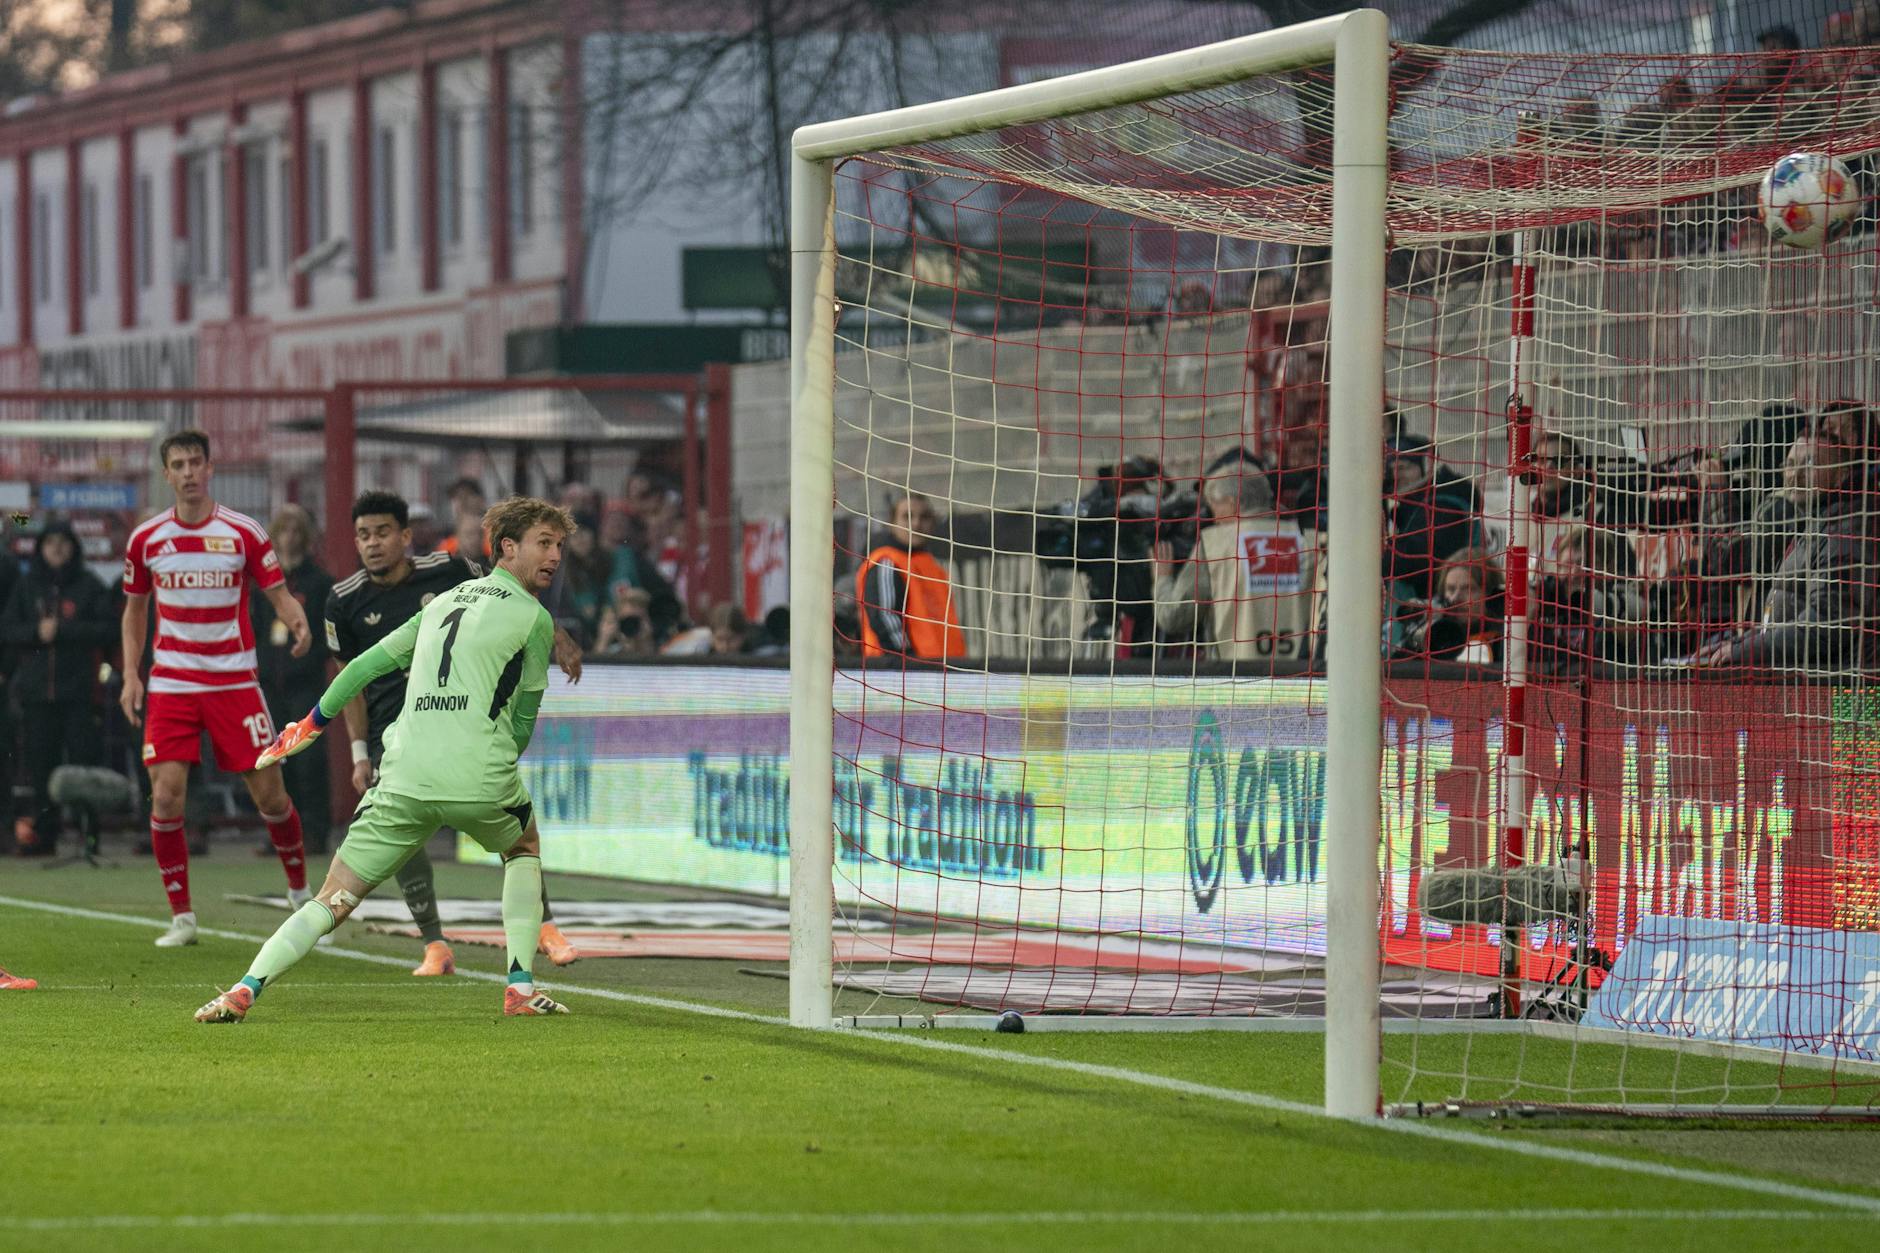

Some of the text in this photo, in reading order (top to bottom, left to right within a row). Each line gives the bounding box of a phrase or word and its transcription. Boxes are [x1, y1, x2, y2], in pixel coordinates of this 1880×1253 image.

[173, 569, 233, 588] raisin
[469, 585, 512, 600] UNION
[453, 594, 480, 604] BERLIN
[438, 607, 468, 688] 1
[1255, 629, 1295, 656] 05
[415, 691, 469, 712] RÖNNOW
[242, 711, 273, 748] 19
[687, 748, 790, 857] Traditi
[881, 754, 1046, 878] Tradition.
[1615, 722, 1795, 951] Markt
[1653, 929, 1789, 1038] raisin
